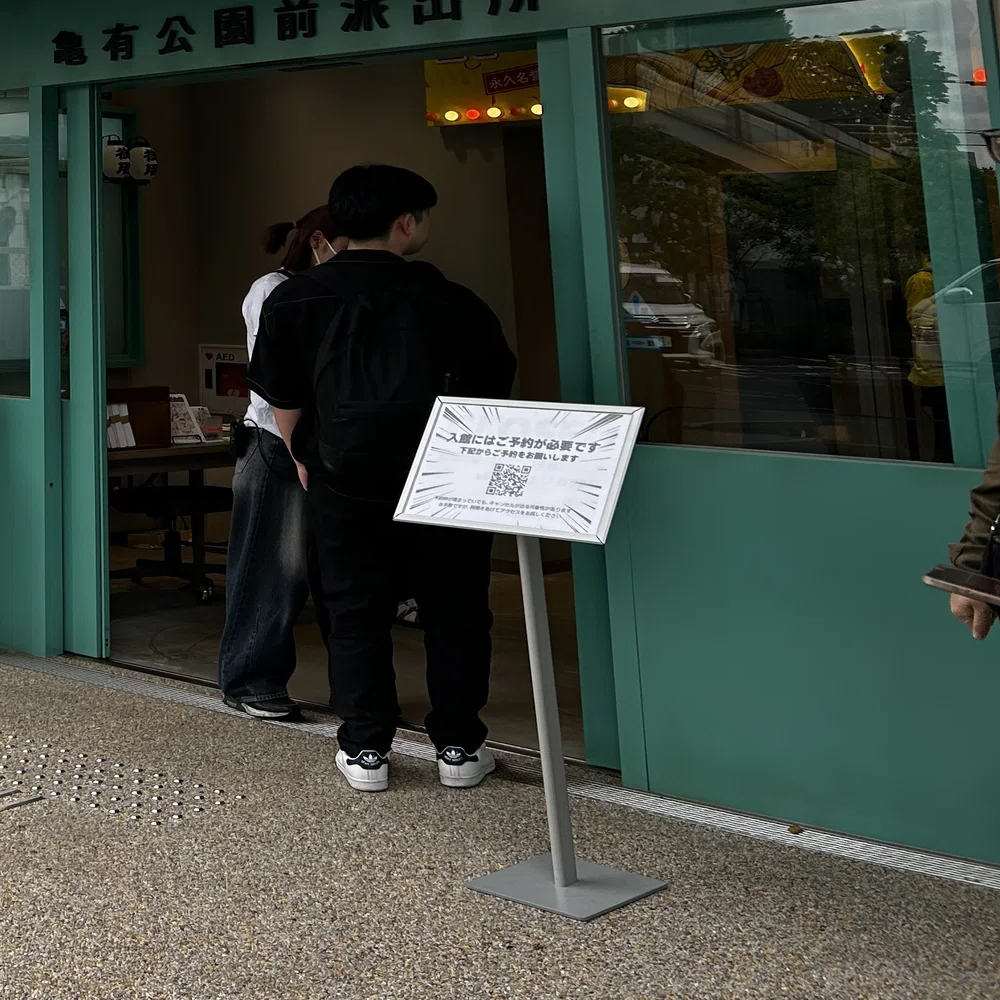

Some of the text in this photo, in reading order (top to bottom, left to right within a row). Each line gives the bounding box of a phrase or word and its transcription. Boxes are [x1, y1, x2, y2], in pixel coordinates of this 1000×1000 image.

[215, 353, 235, 361] AED
[447, 432, 601, 453] 入館にはご予約が必要です
[460, 446, 579, 462] 下記からご予約をお願いします
